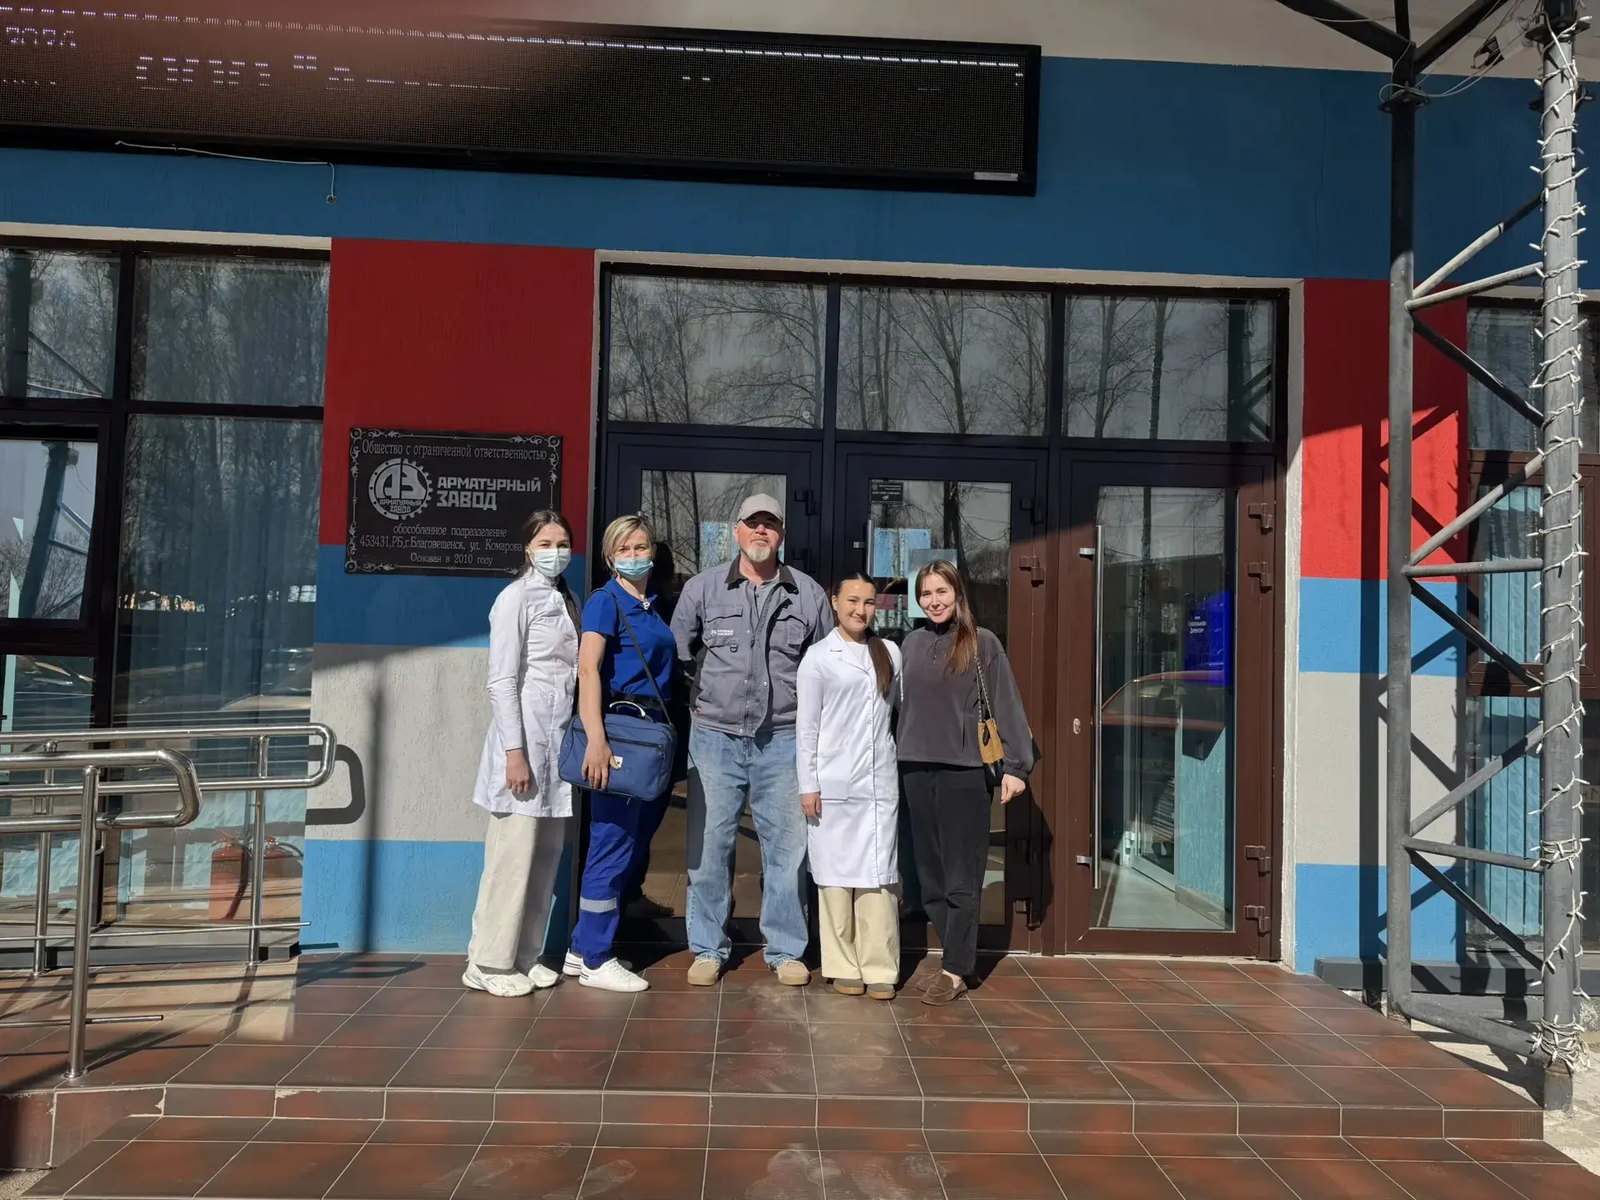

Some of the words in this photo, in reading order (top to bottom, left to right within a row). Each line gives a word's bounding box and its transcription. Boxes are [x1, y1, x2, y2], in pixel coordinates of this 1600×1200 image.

[362, 439, 403, 455] Общество
[406, 446, 411, 455] с
[413, 445, 472, 458] ограниченной
[474, 448, 547, 461] ответственностью
[437, 476, 542, 492] АРМАТУРНЫЙ
[380, 498, 422, 507] АРМАТУРНЫЙ
[436, 491, 497, 511] ЗАВОД
[390, 505, 411, 513] ЗАВОД
[393, 523, 447, 536] обособленное
[451, 526, 508, 539] подразделение
[485, 538, 523, 553] Комарова
[410, 552, 442, 563] Основан
[454, 554, 473, 564] 2010
[477, 556, 494, 565] году
